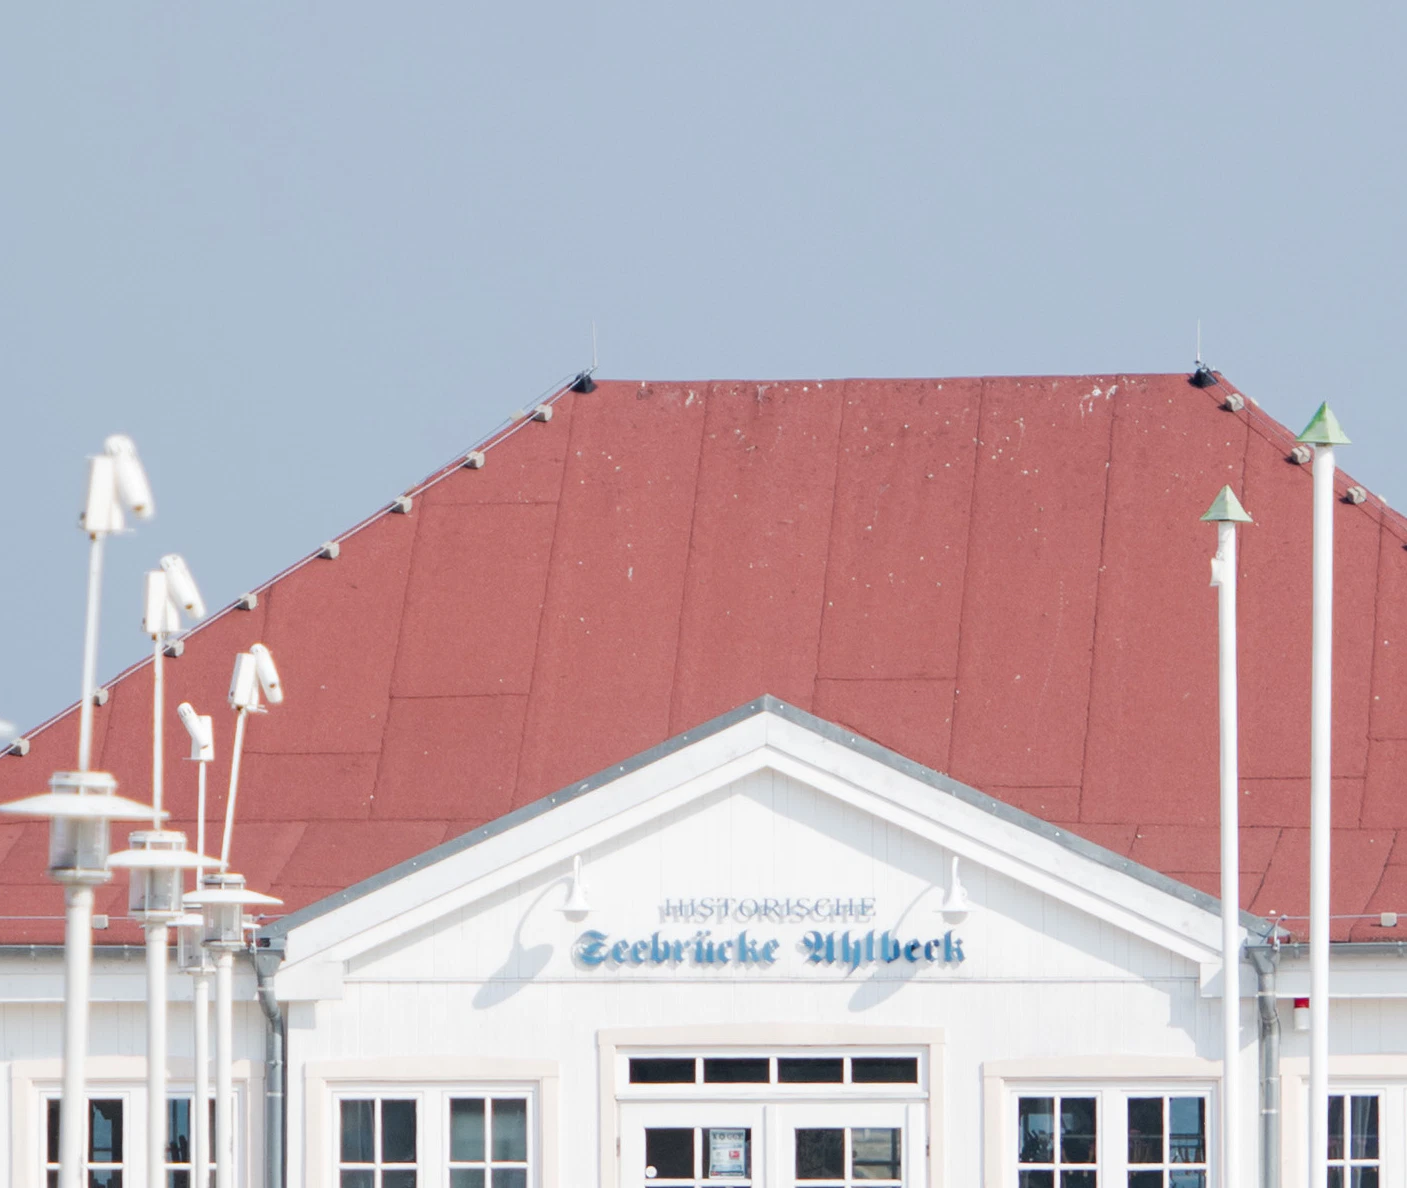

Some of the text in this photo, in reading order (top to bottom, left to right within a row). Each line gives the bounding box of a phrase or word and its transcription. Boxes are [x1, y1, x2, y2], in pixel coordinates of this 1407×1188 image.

[664, 897, 877, 917] HISTORISCHE
[576, 929, 966, 979] Seebrücke Ahlbeck
